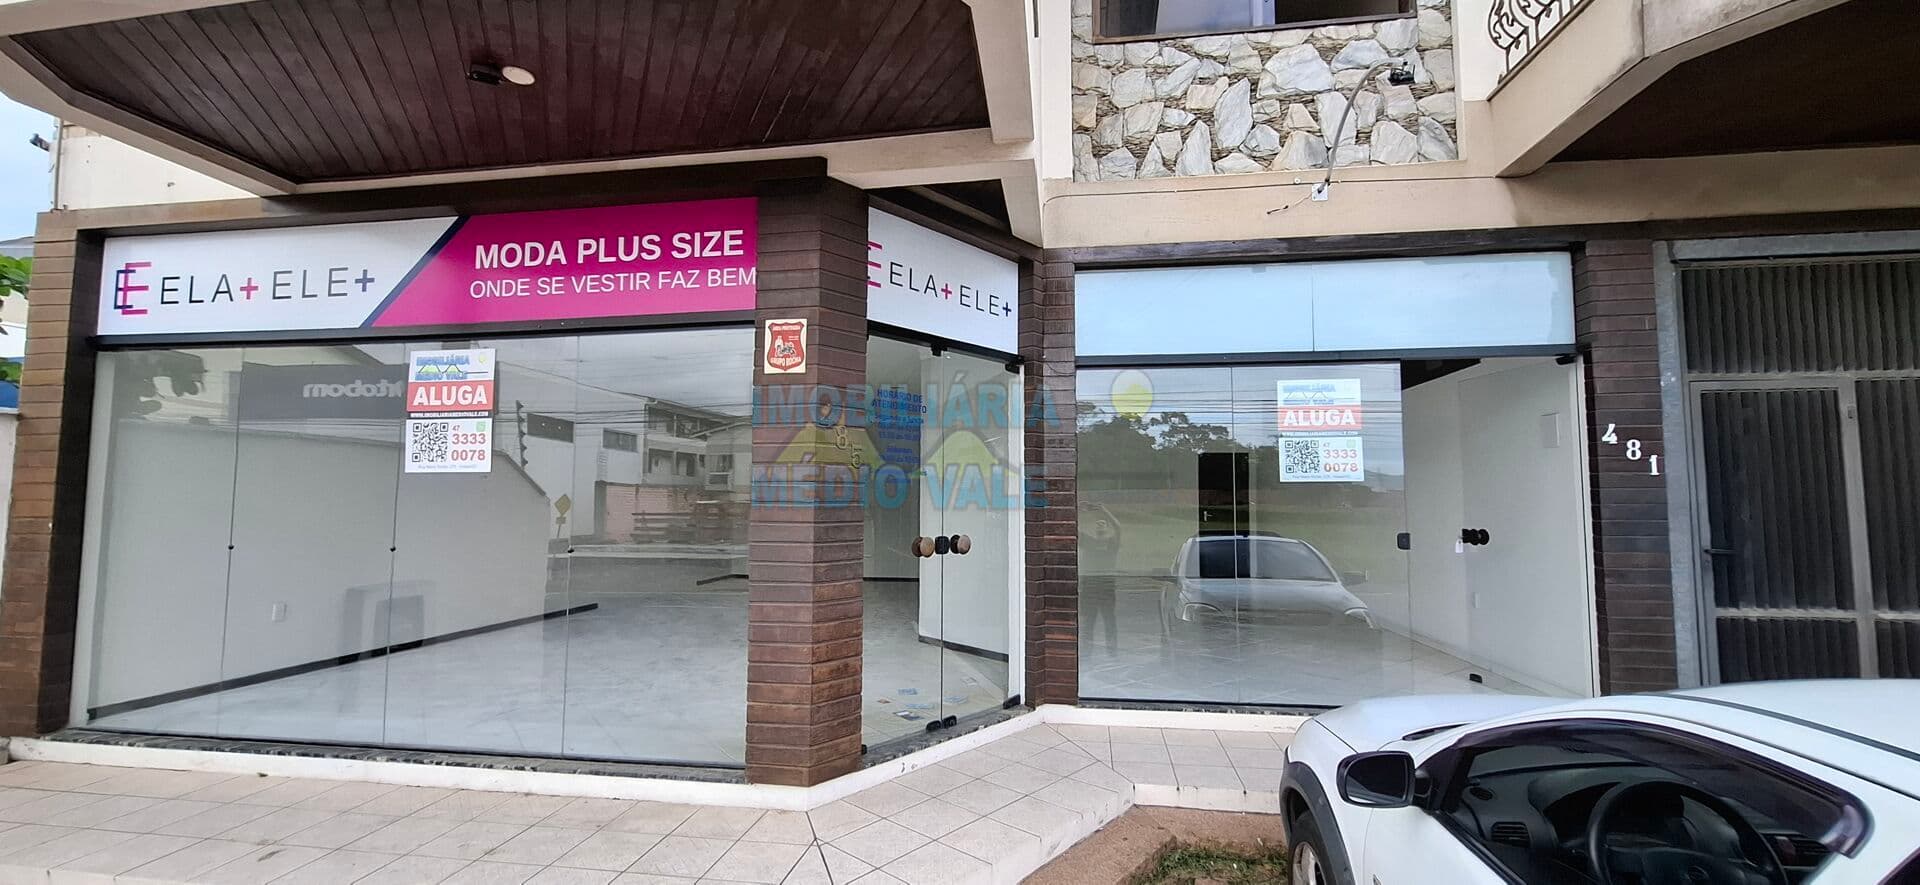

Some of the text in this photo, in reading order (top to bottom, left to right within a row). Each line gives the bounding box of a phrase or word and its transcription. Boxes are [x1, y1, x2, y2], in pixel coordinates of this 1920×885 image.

[475, 229, 744, 269] MODA PLUS SIZE
[469, 266, 756, 299] ONDE SE VESTIR FAZ BEM
[412, 384, 488, 406] ALUGA
[1283, 409, 1356, 427] ALUGA
[451, 432, 487, 445] 3333
[451, 449, 486, 461] 0078
[1323, 449, 1358, 460] 3333
[1601, 423, 1661, 476] 481
[1323, 462, 1359, 473] 0078
